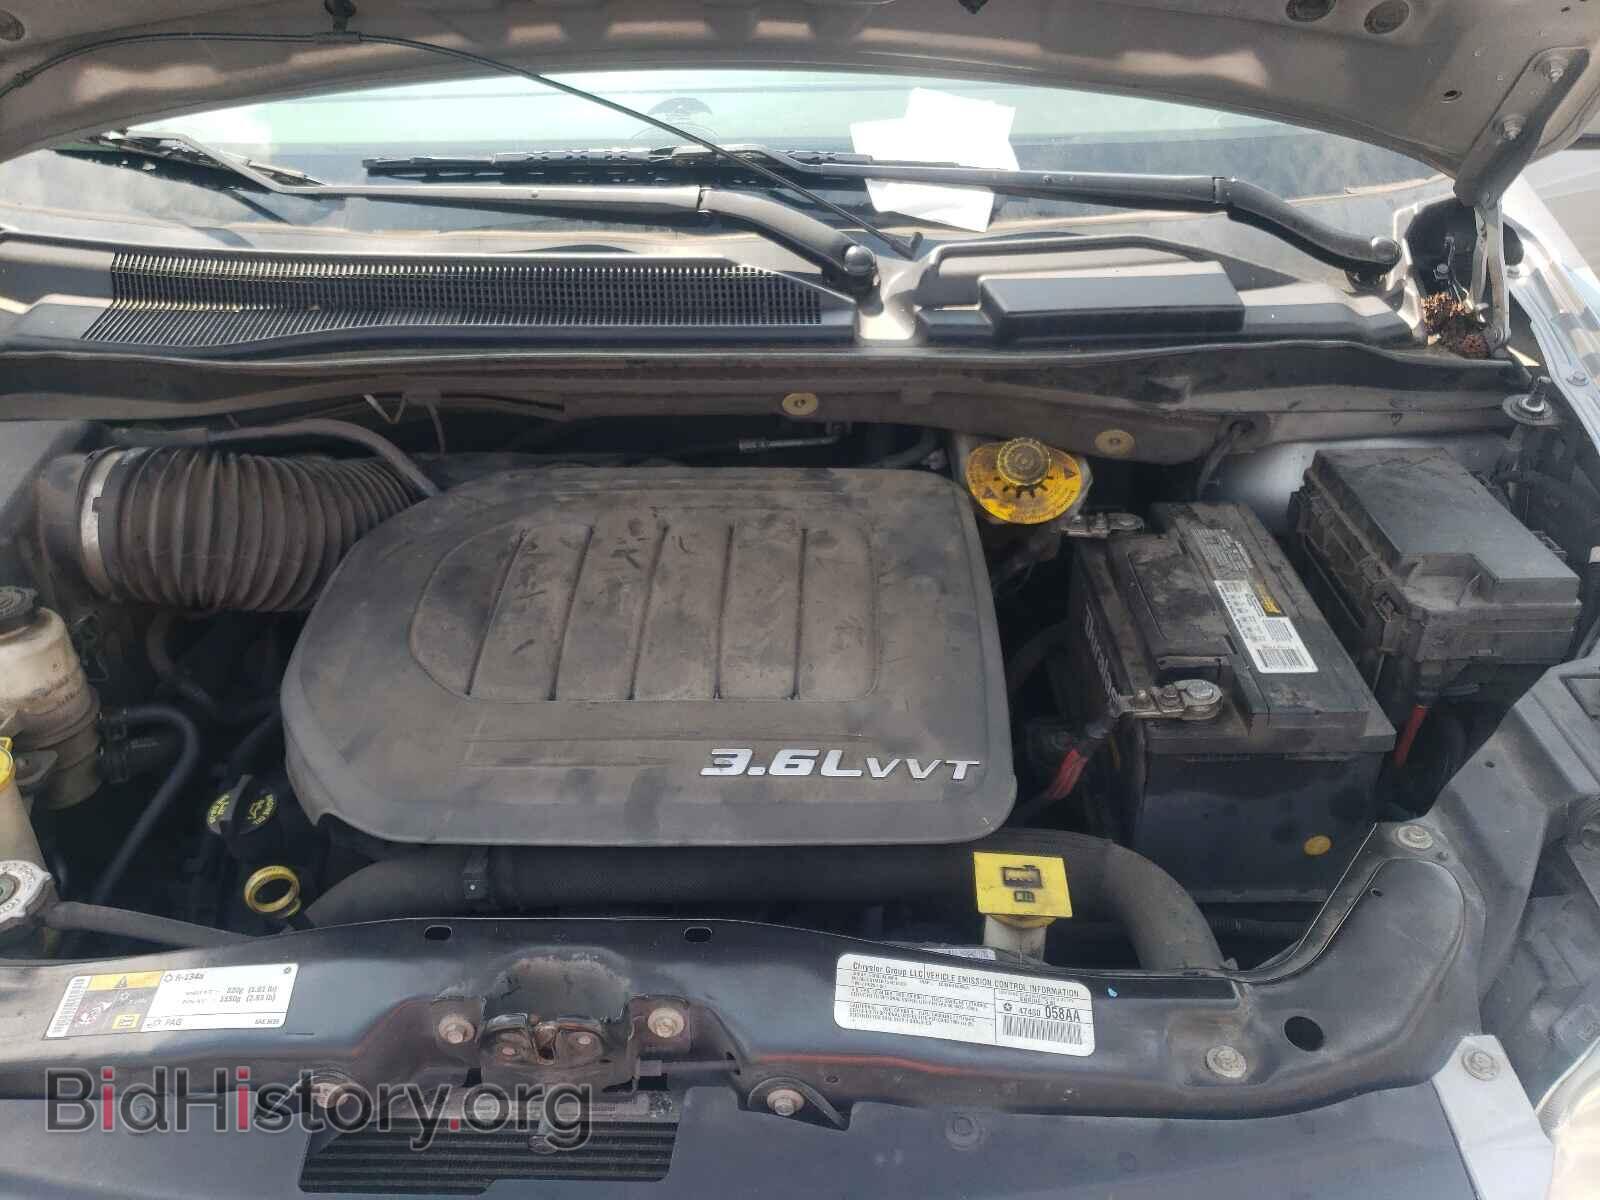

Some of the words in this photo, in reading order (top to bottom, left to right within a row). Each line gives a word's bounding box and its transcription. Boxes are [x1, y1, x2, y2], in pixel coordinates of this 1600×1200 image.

[700, 748, 863, 777] 3.6L
[866, 756, 981, 780] VVT
[853, 961, 882, 973] Chrysler
[886, 967, 907, 978] Group
[910, 969, 924, 978] LLC
[926, 971, 955, 982] VEHICLE
[958, 976, 992, 987] EMISSION
[995, 980, 1026, 991] CONTROL
[1029, 985, 1079, 997] INFORMATION
[164, 1018, 183, 1027] PAG
